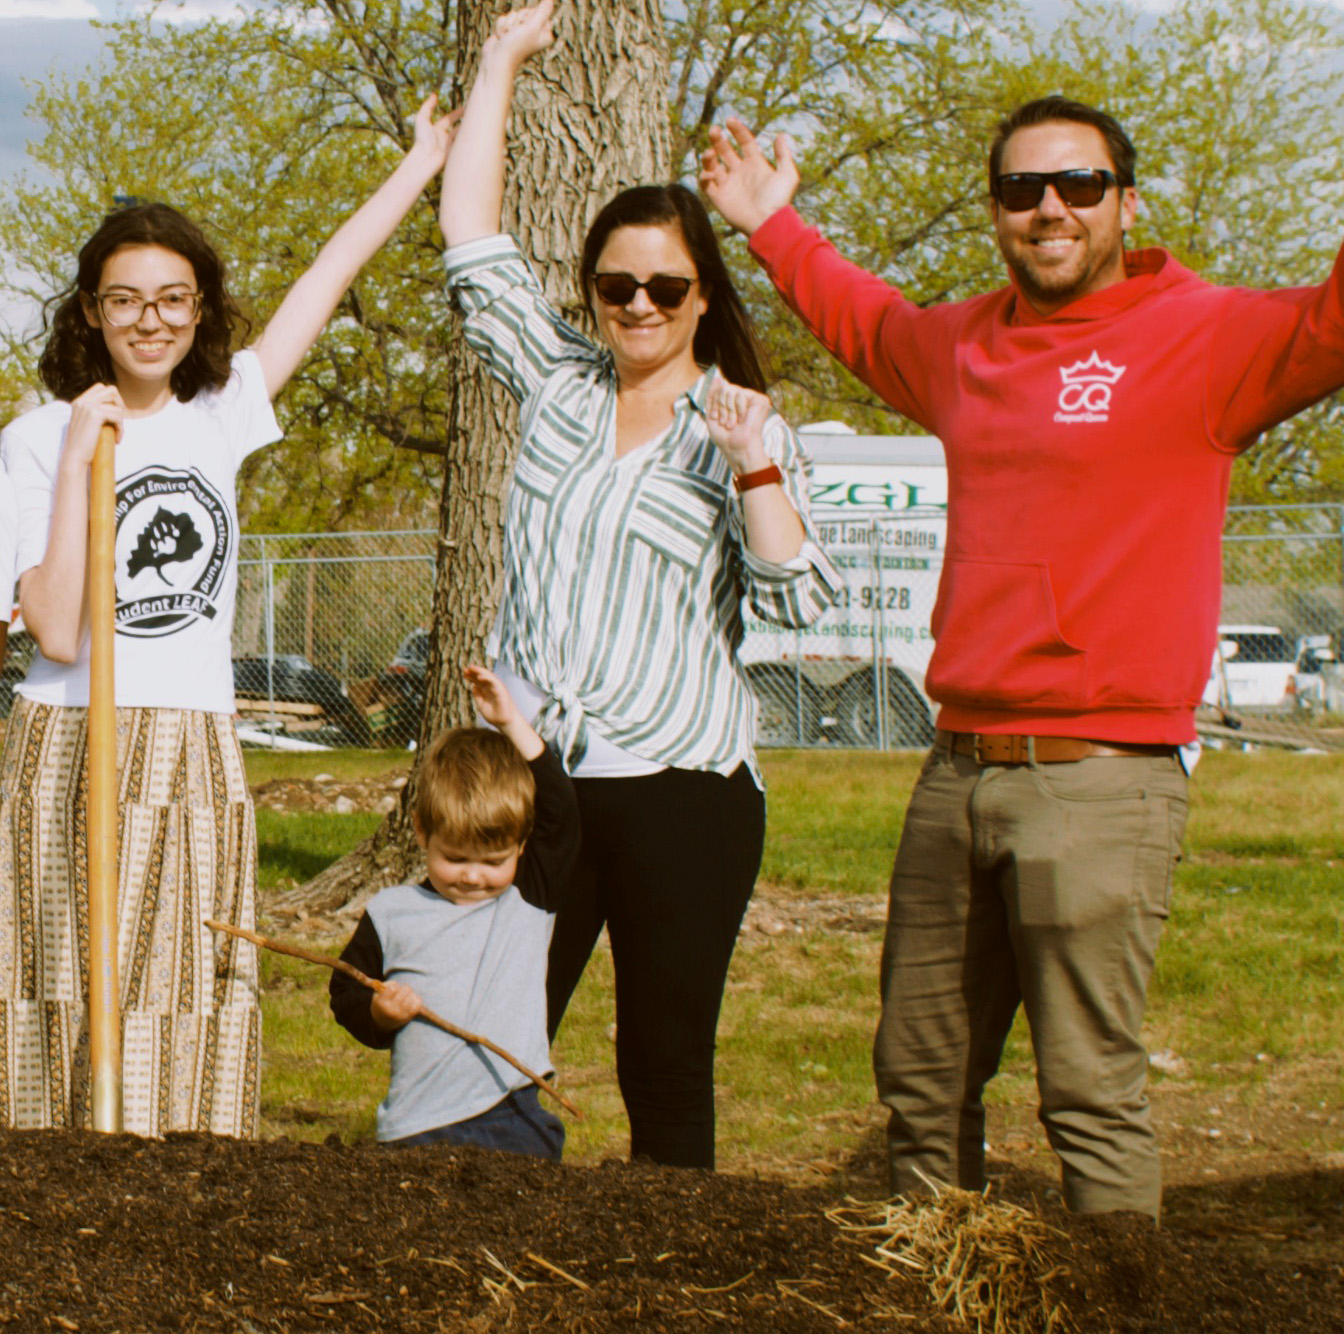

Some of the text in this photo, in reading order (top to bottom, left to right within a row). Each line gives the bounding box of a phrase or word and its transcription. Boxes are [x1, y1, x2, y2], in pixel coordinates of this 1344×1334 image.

[1058, 383, 1112, 411] CQ
[810, 481, 947, 510] ZGL
[125, 480, 227, 594] For Enviroental Action Fund
[173, 595, 209, 614] LEAF
